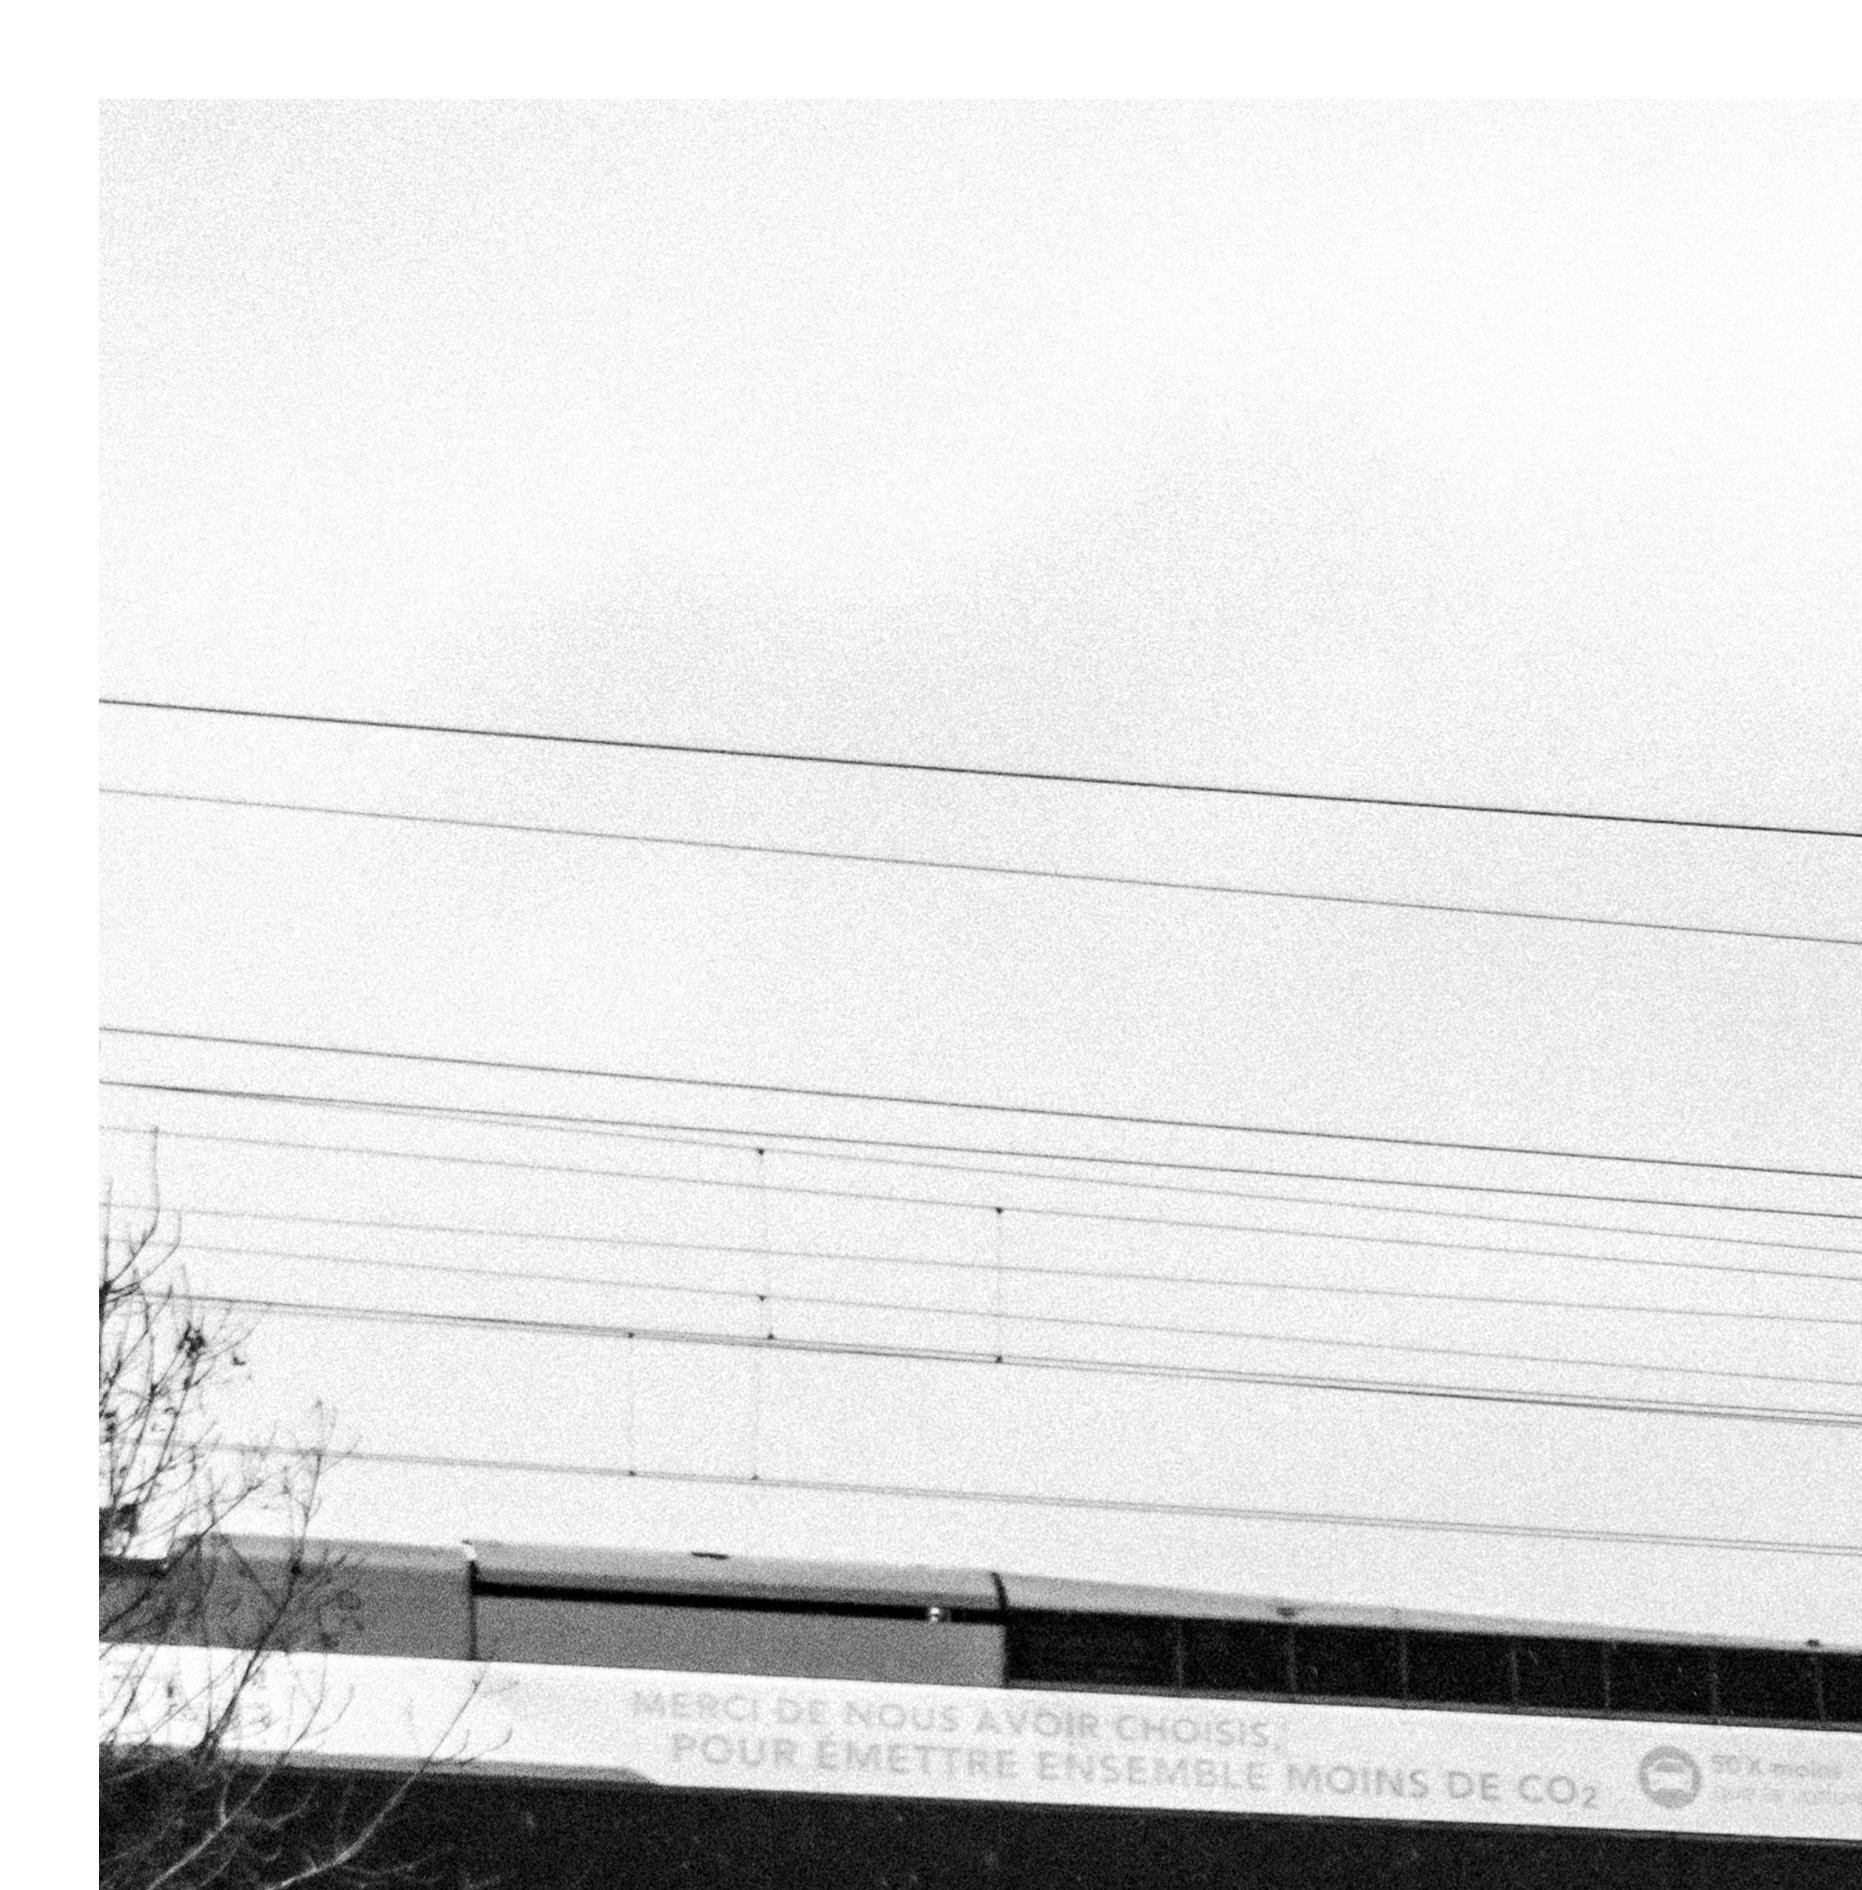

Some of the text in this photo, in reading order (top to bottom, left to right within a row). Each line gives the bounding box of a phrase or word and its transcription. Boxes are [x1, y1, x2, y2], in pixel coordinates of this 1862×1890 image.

[631, 1690, 759, 1723] MERCI
[774, 1696, 826, 1727] DE
[845, 1701, 959, 1733] NOUS
[975, 1709, 1099, 1740] AVOIR
[672, 1732, 798, 1768] POUR
[815, 1733, 1016, 1779] ÉMETTRE
[1037, 1750, 1267, 1792] ENSEMBLE
[1287, 1763, 1430, 1800] MOINS
[1446, 1770, 1501, 1803] DE
